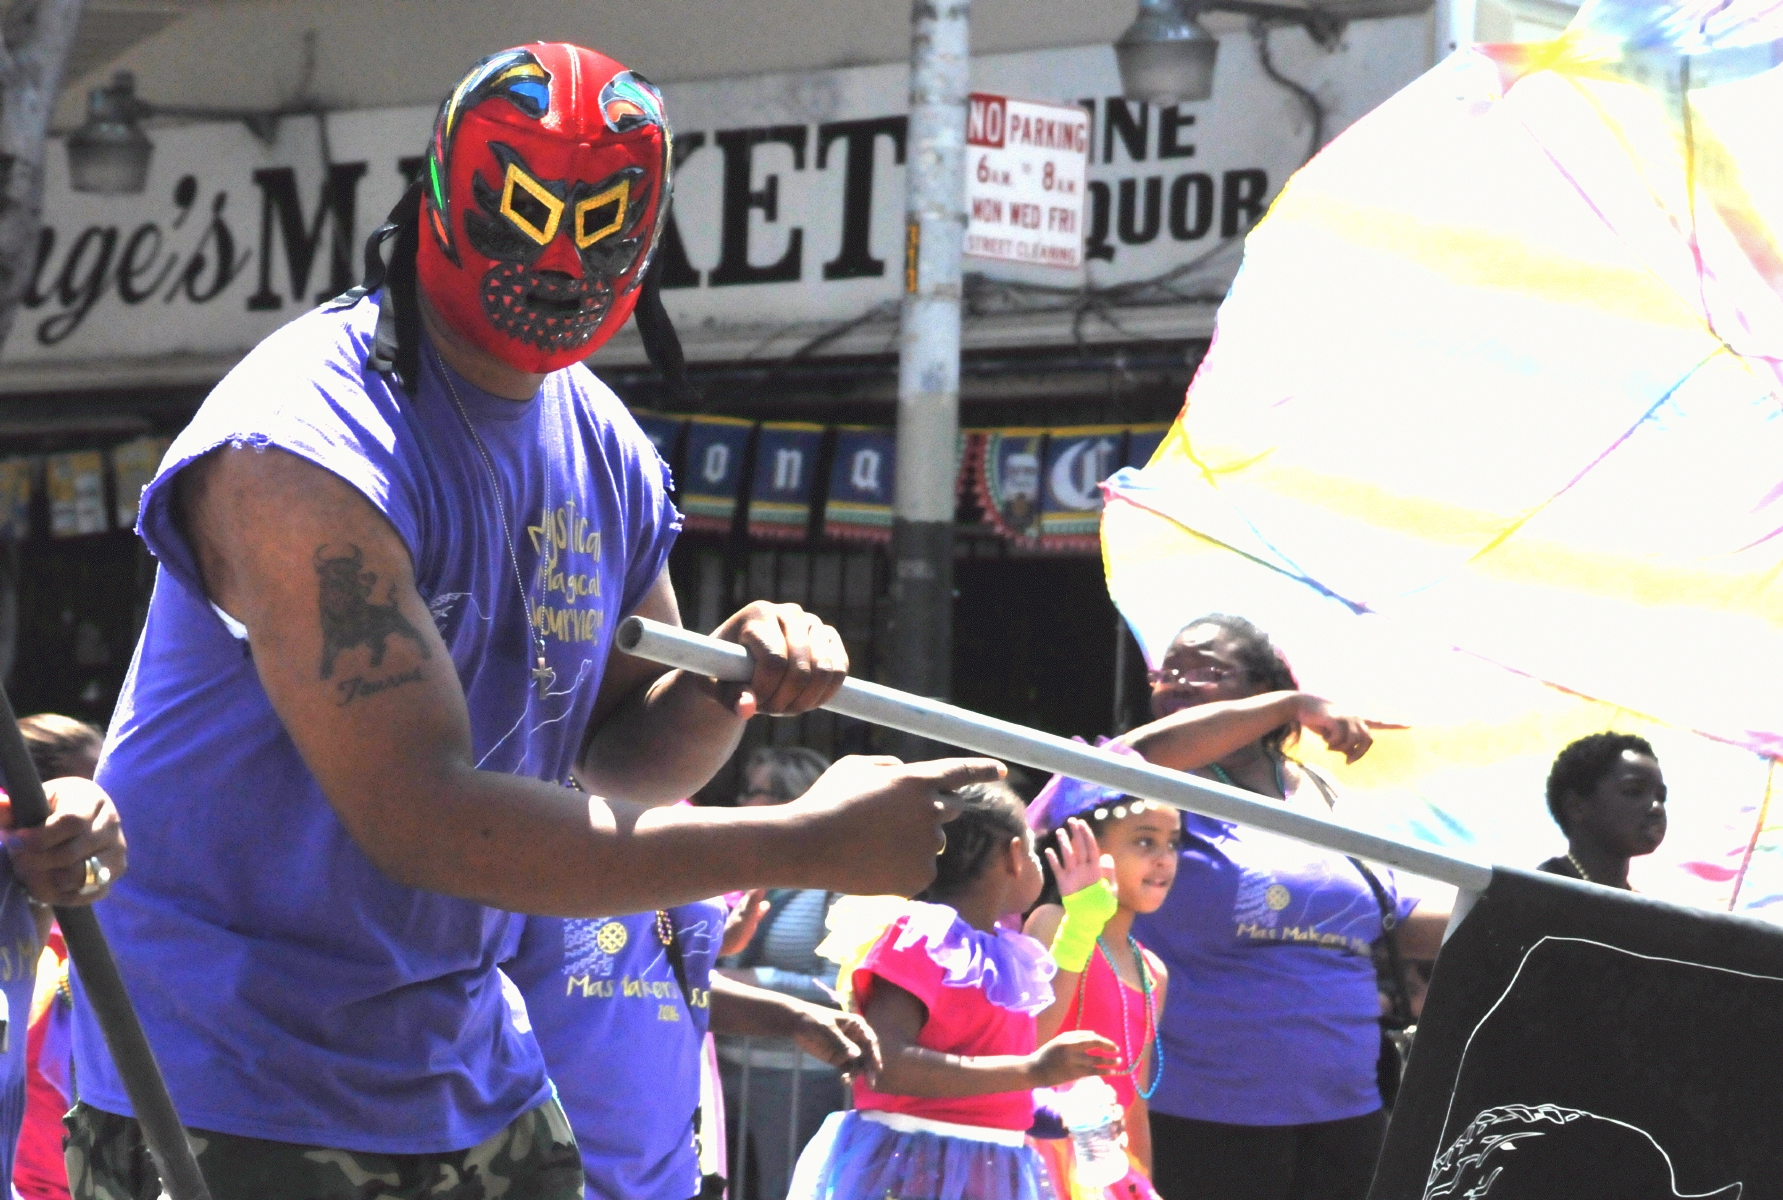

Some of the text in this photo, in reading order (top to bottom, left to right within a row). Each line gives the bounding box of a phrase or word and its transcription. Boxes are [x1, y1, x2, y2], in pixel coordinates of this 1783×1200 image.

[969, 100, 1086, 154] NO PARKING
[972, 199, 1076, 234] MON WED FRI
[1085, 168, 1268, 262] QUOR
[968, 233, 1012, 258] STREET
[527, 494, 602, 570] Mystica
[1235, 922, 1276, 941] Mas
[565, 974, 614, 999] Mas
